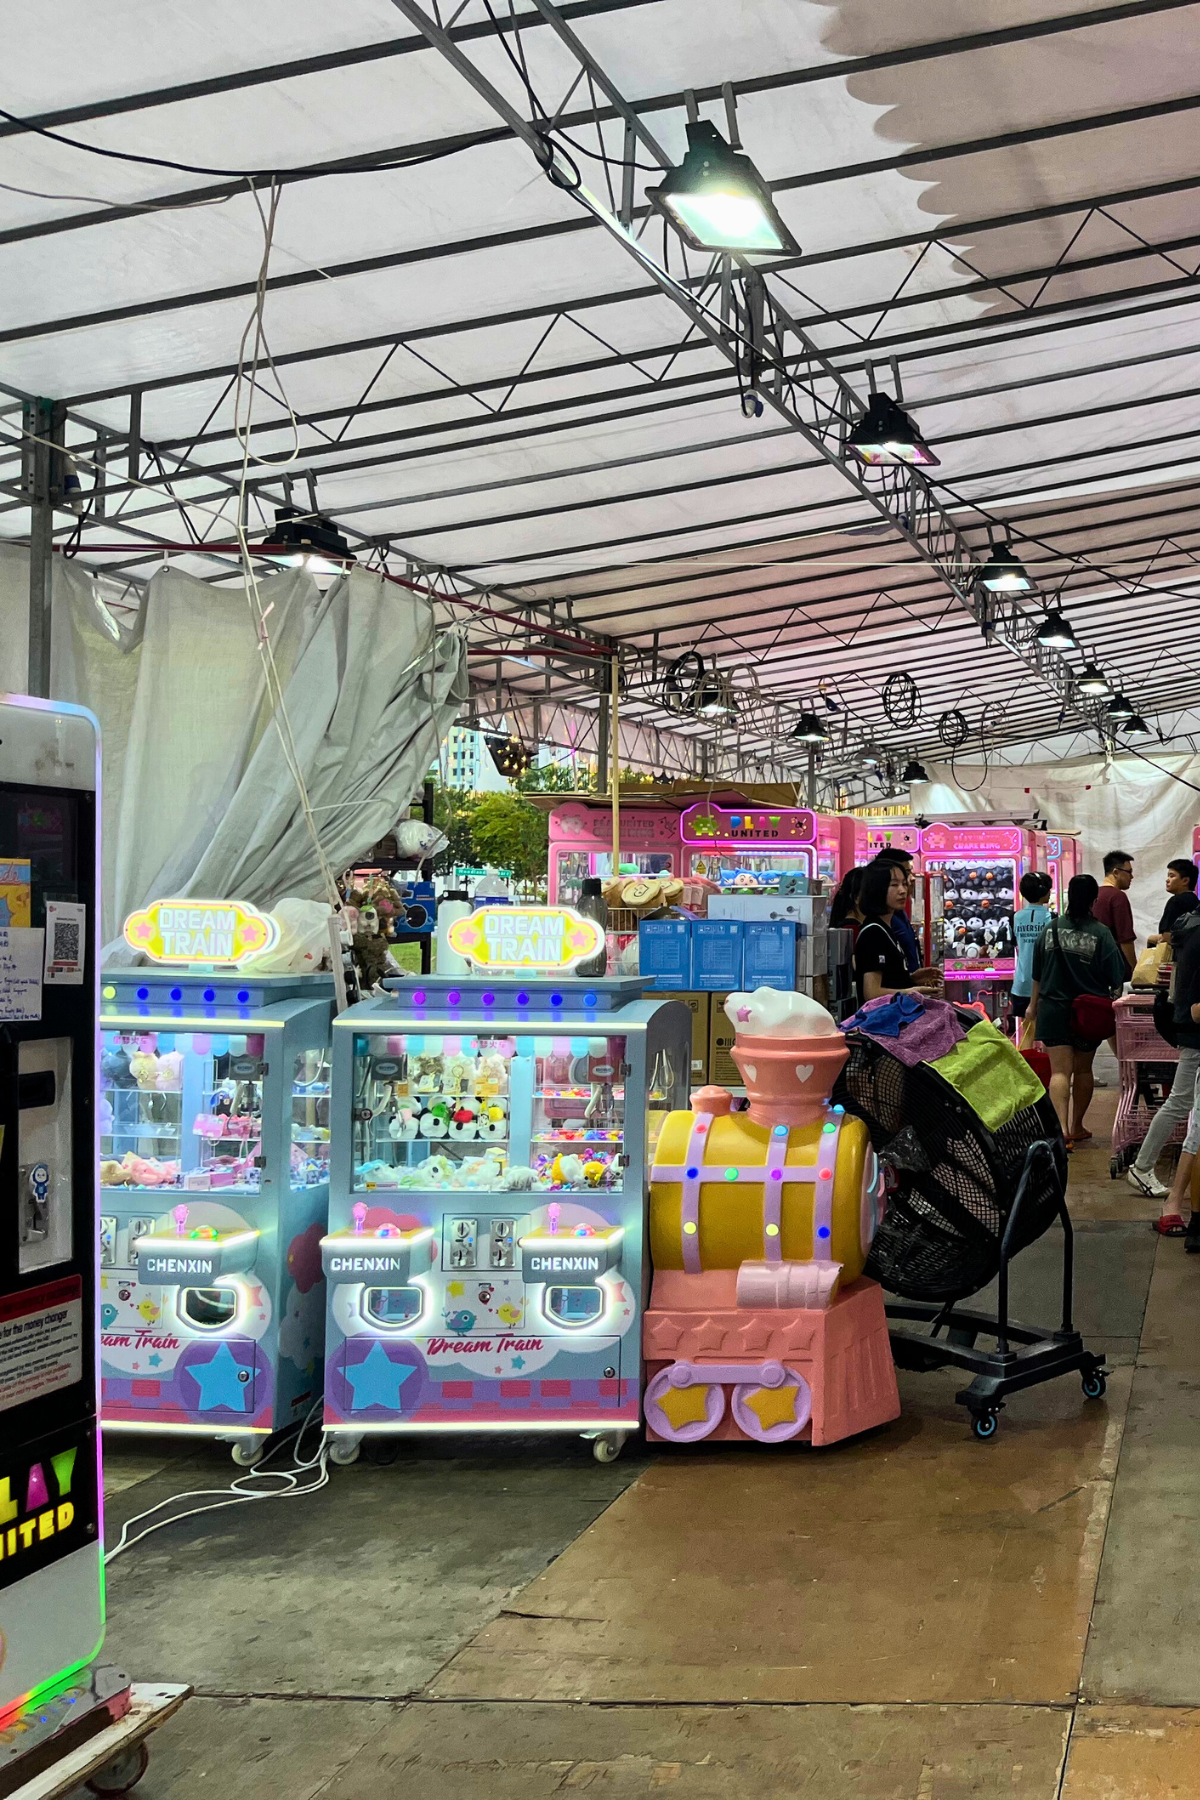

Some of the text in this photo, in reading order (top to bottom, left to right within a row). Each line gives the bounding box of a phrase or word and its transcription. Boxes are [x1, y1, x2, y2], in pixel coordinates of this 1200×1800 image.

[730, 816, 781, 829] PLAY
[868, 832, 893, 842] LAY
[158, 908, 235, 930] DREAM
[484, 914, 564, 936] DREAM
[160, 932, 233, 956] TRAIN
[487, 937, 561, 961] TRAIN
[147, 1259, 212, 1273] CHENXIN
[331, 1257, 400, 1271] CHENXIN
[531, 1257, 598, 1270] CHENXIN
[135, 1329, 181, 1349] Train
[427, 1333, 543, 1355] Dream Train
[0, 1446, 78, 1525] LAY
[0, 1501, 75, 1561] ITED
